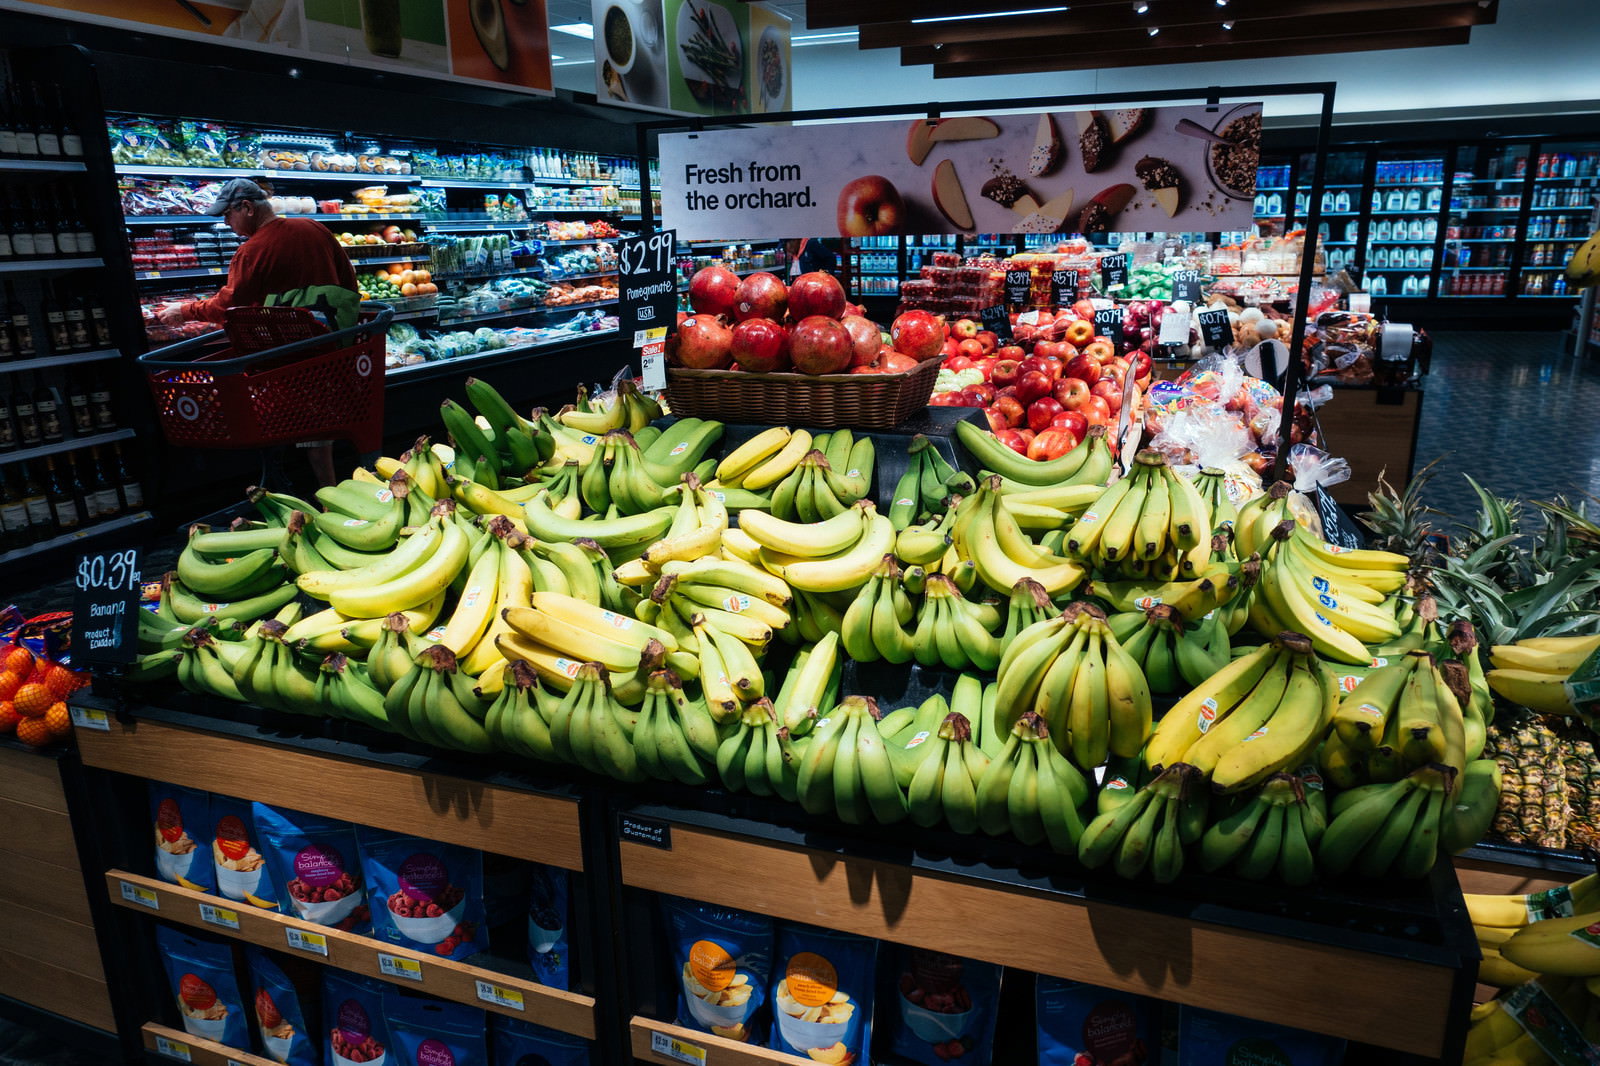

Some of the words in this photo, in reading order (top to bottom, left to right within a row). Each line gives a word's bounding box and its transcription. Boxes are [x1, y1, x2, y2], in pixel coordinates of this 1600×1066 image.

[685, 162, 743, 185] Fresh
[748, 161, 801, 182] from
[685, 190, 719, 211] the
[725, 186, 817, 210] orchard.
[619, 232, 673, 276] $2.99
[626, 280, 673, 302] Pomegranate
[638, 307, 653, 319] USA
[1200, 311, 1226, 325] $0.79
[642, 344, 662, 355] Sale!
[75, 549, 137, 591] $0.39
[90, 600, 126, 617] Banana
[85, 627, 110, 640] Product
[90, 637, 115, 650] Ecuador
[623, 820, 652, 832] Product
